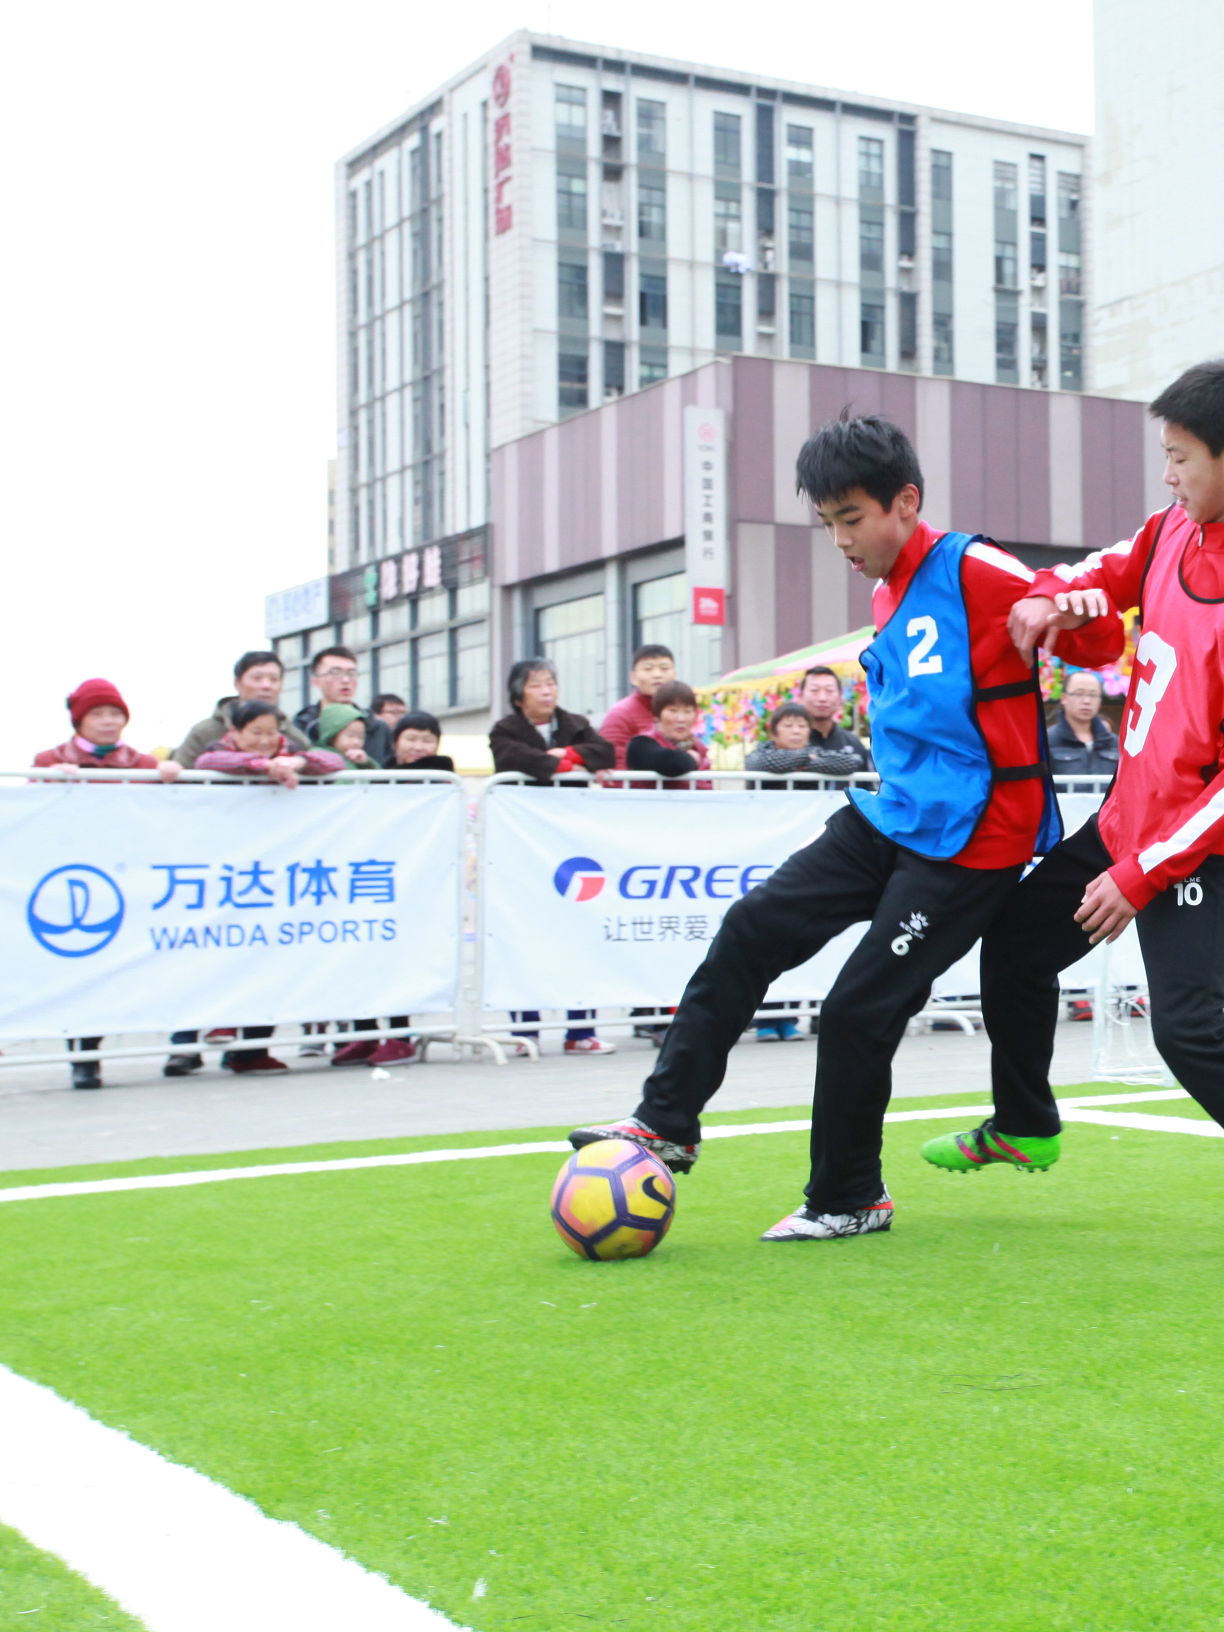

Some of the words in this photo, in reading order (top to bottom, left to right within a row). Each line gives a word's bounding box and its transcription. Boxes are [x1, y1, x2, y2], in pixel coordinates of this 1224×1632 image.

[906, 615, 943, 678] 2
[1123, 630, 1178, 758] 3
[149, 858, 396, 911] 万达体育
[618, 865, 774, 900] GREE
[1173, 882, 1204, 906] 10
[150, 923, 269, 951] WANDA
[277, 918, 397, 946] SPORTS
[891, 933, 913, 956] 6
